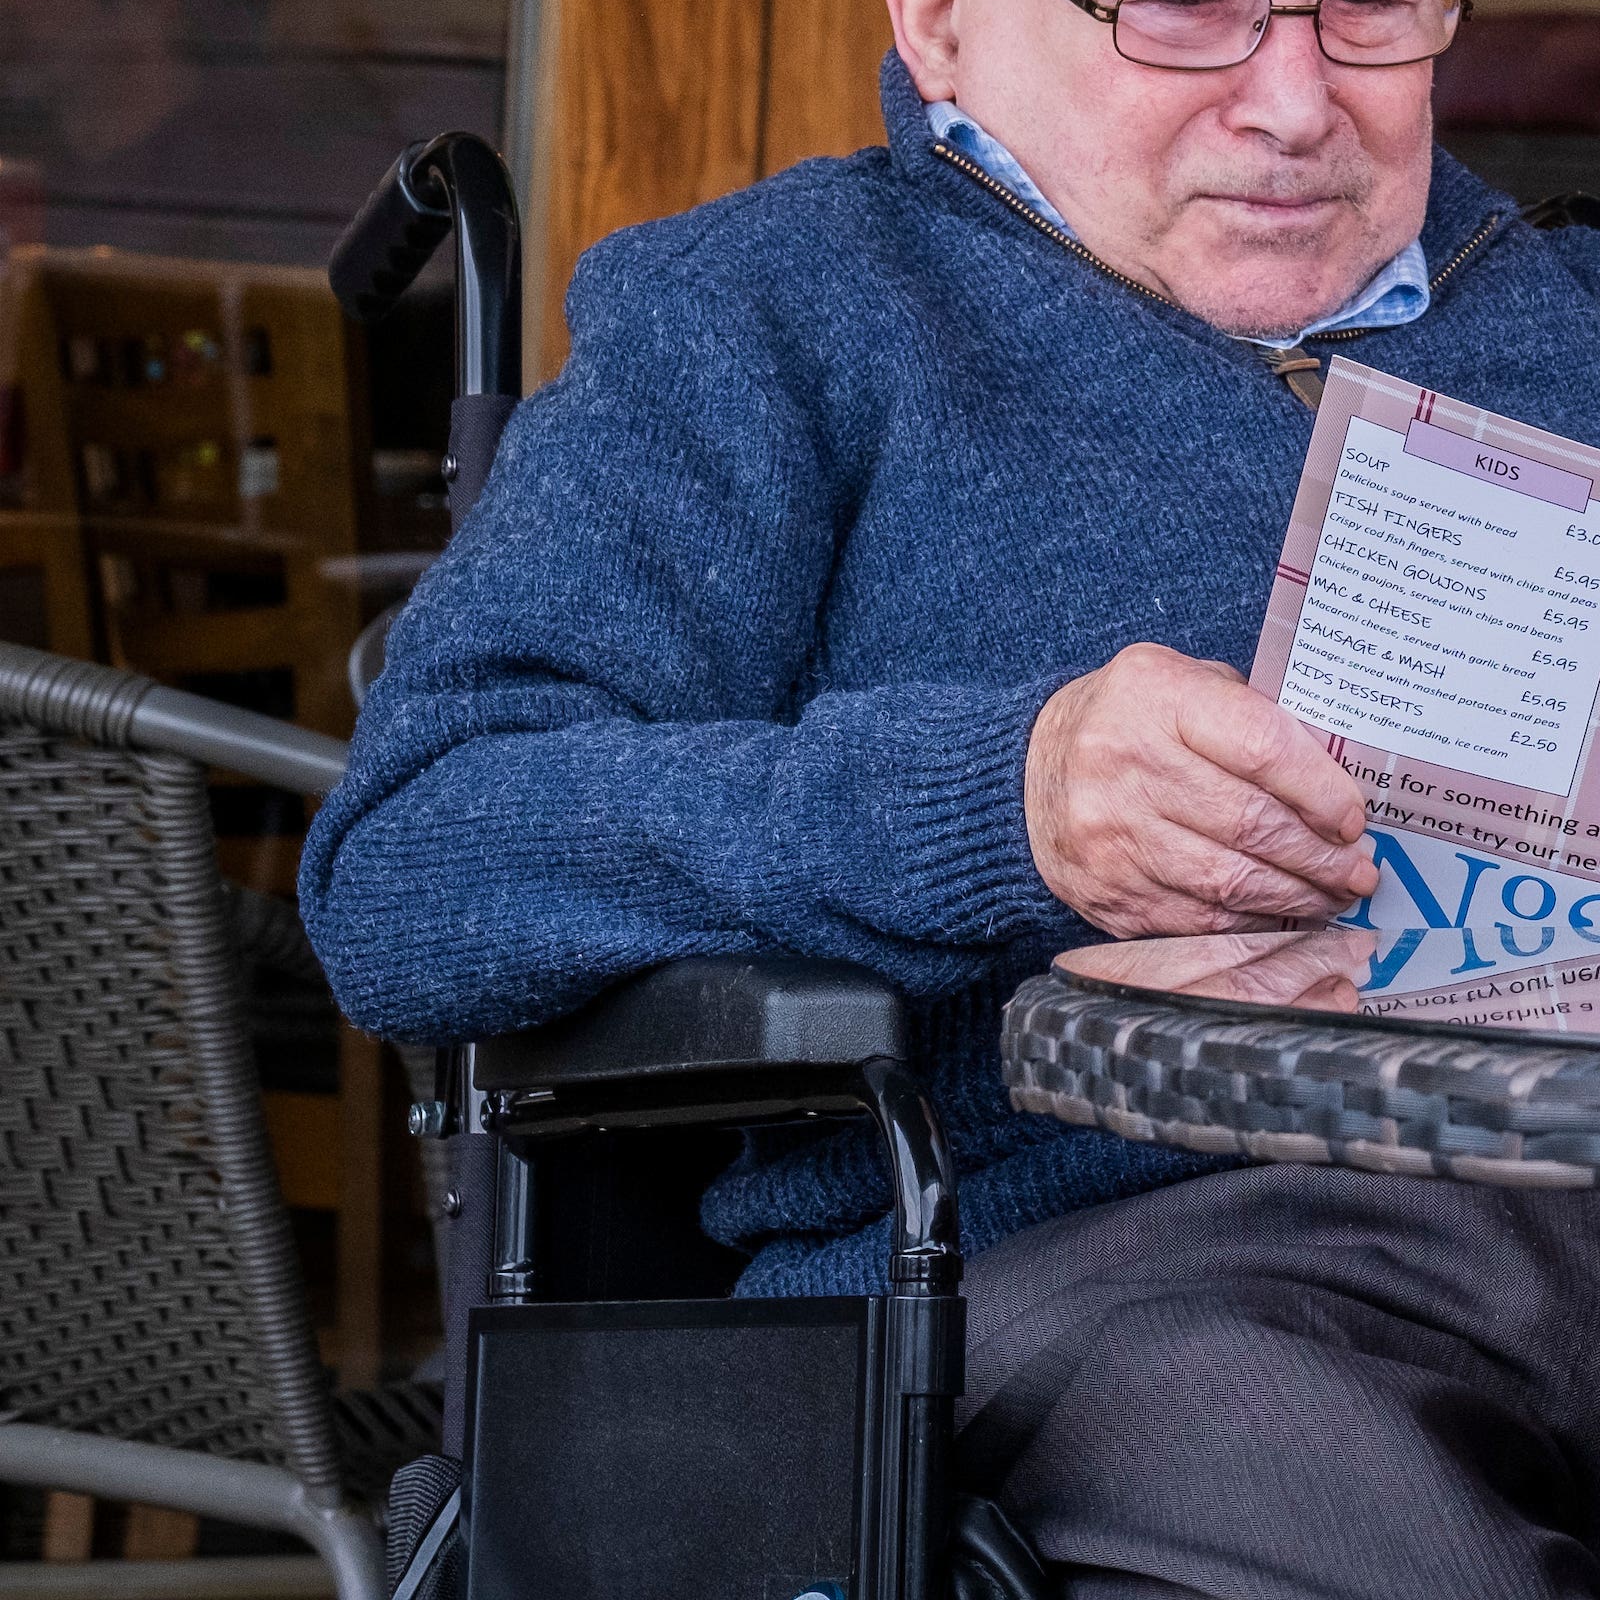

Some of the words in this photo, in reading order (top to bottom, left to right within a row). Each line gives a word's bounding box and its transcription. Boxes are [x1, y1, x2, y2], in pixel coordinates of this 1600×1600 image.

[1346, 448, 1390, 472] SOUP
[1475, 453, 1520, 481] KIDS
[1335, 490, 1379, 517] FISH
[1383, 509, 1463, 546] FINGERS
[1340, 468, 1389, 493] Delicious
[1390, 489, 1417, 504] soup
[1418, 500, 1457, 518] served
[1458, 513, 1482, 527] with
[1484, 520, 1518, 538] bread
[1324, 534, 1398, 571] CHICKEN
[1402, 564, 1487, 601] GOUJONS
[1329, 512, 1362, 531] Crispy
[1364, 527, 1385, 539] cod
[1384, 533, 1406, 547] fish
[1405, 541, 1447, 563] fingers,
[1450, 558, 1489, 575] served
[1490, 571, 1514, 584] with
[1516, 579, 1545, 593] chips
[1547, 589, 1571, 600] and
[1569, 596, 1598, 609] peas
[1553, 566, 1600, 590] £5.95
[1314, 575, 1348, 598] MAC
[1351, 593, 1365, 604] &
[1368, 598, 1432, 629] CHEESE
[1318, 554, 1360, 577] Chicken
[1361, 573, 1406, 595] goujons,
[1409, 590, 1448, 608] served
[1449, 604, 1473, 616] with
[1475, 612, 1503, 626] chips
[1506, 622, 1529, 633] and
[1529, 627, 1564, 644] beans
[1543, 608, 1589, 631] £5.95
[1302, 618, 1378, 656] SAUSAGE
[1381, 650, 1394, 661] &
[1399, 654, 1446, 679] MASH
[1308, 596, 1360, 622] Macaroni
[1361, 619, 1399, 639] cheese,
[1403, 635, 1441, 651] served
[1442, 647, 1466, 660] with
[1468, 655, 1500, 670] garlic
[1502, 663, 1536, 679] bread
[1531, 649, 1578, 672] £5.95
[1291, 658, 1334, 685] KIDS
[1337, 677, 1424, 717] DESSERTS
[1296, 638, 1345, 664] Sausages
[1347, 660, 1385, 678] served
[1386, 674, 1410, 687] with
[1412, 683, 1458, 701] mashed
[1457, 697, 1508, 716] potatoes
[1510, 711, 1533, 722] and
[1532, 718, 1560, 729] peas
[1520, 690, 1567, 712] £5.95
[1282, 698, 1294, 706] or
[1294, 702, 1326, 722] fudge
[1328, 717, 1353, 731] cake
[1286, 681, 1321, 701] Choice
[1322, 697, 1336, 708] of
[1336, 702, 1368, 719] sticky
[1369, 713, 1402, 729] toffee
[1402, 725, 1451, 745] pudding,
[1454, 737, 1471, 749] ice
[1473, 745, 1508, 758] cream
[1509, 731, 1557, 752] £2.50
[1341, 755, 1393, 789] king
[1399, 773, 1438, 797] for
[1442, 787, 1580, 837] something
[1585, 823, 1600, 838] a
[1365, 797, 1415, 825] Why
[1422, 812, 1465, 837] not
[1472, 825, 1510, 850] try
[1514, 840, 1560, 861] our
